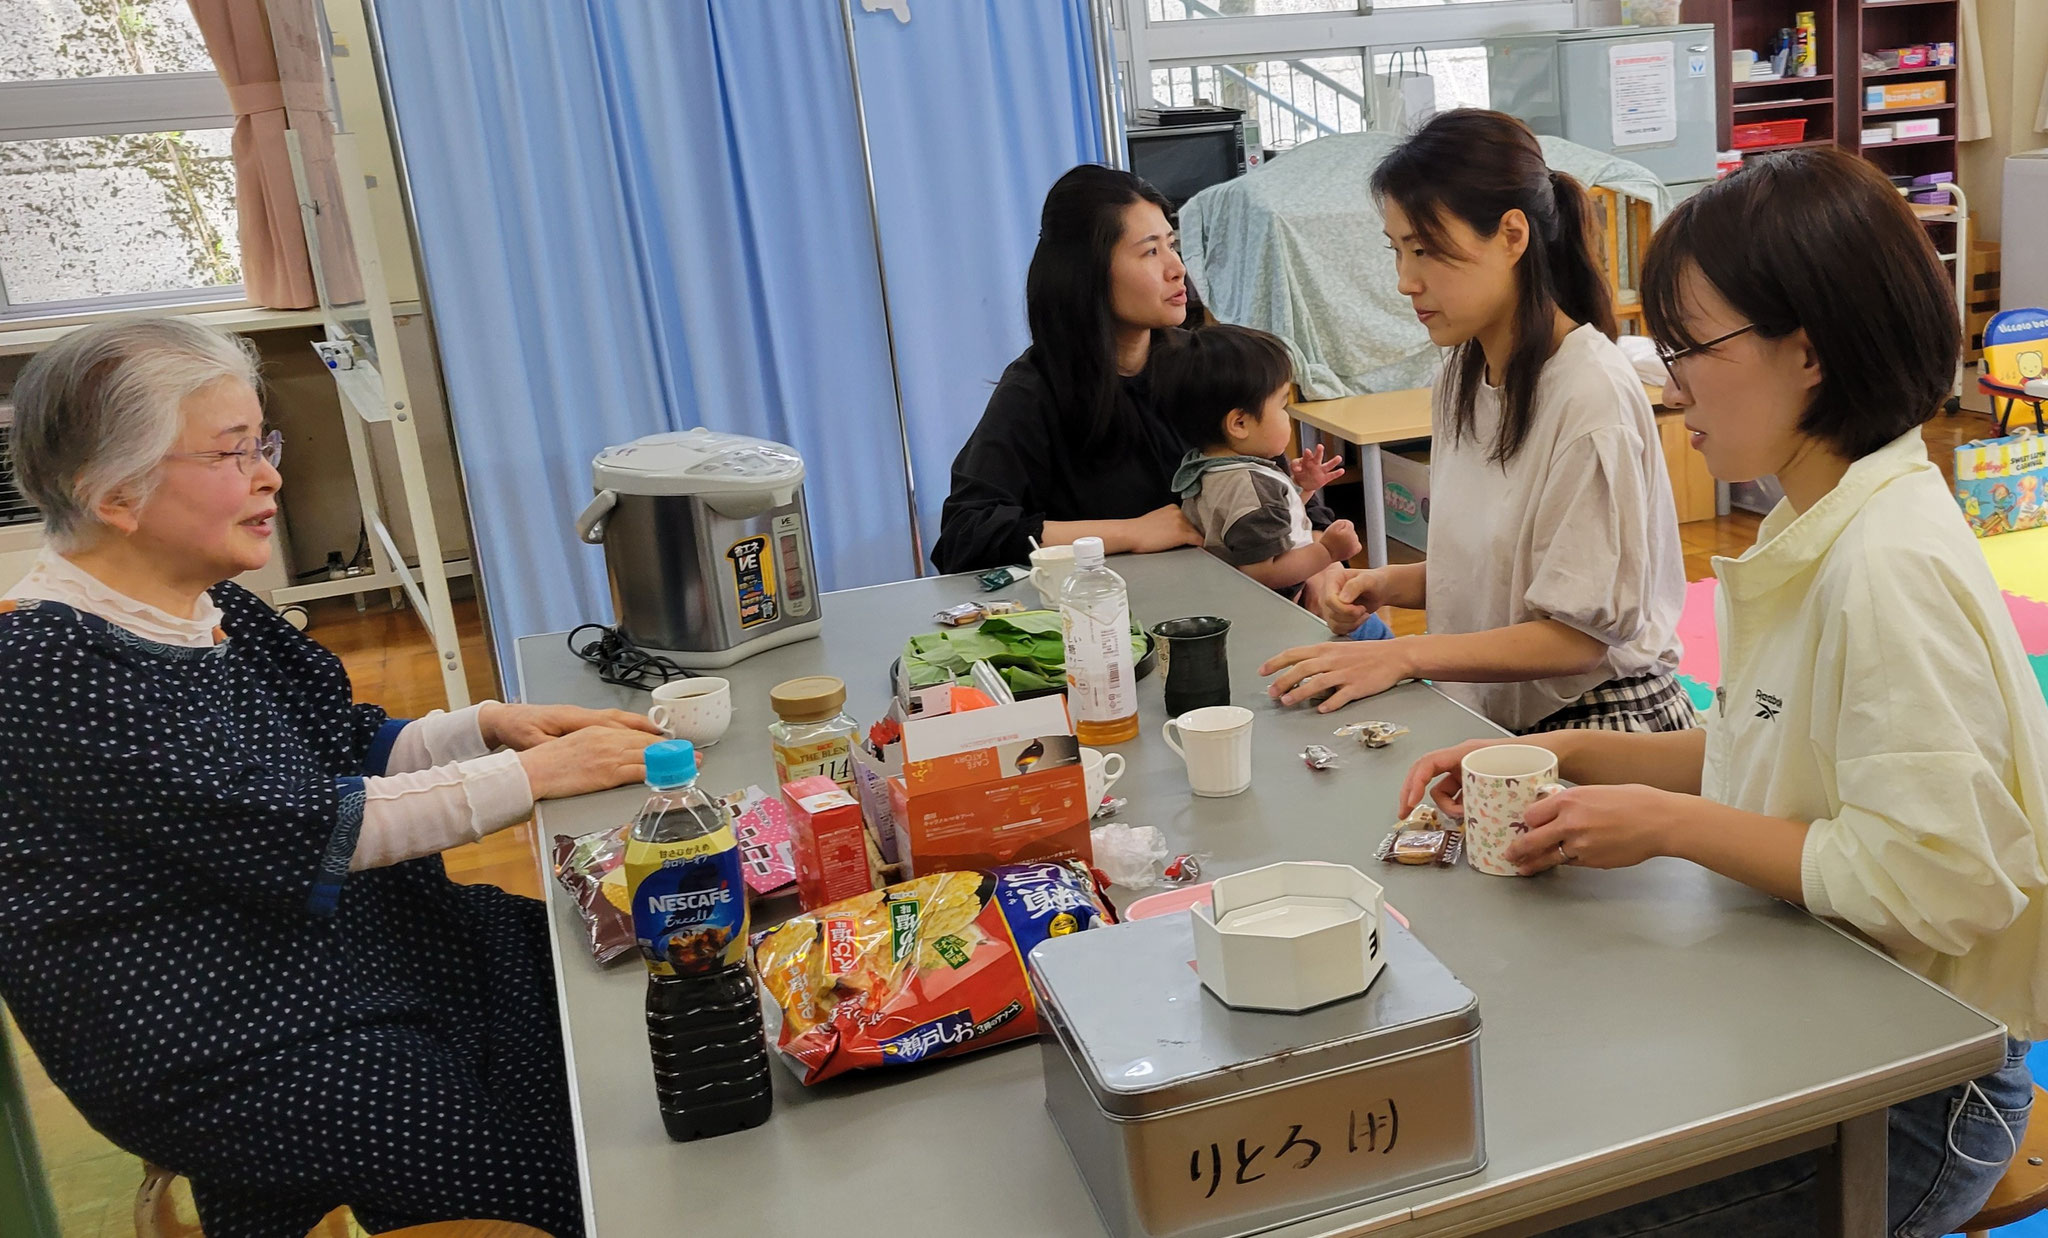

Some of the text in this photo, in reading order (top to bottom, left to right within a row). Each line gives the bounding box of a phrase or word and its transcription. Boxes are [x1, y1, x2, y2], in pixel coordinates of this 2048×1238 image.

[734, 541, 760, 558] 省エネ
[738, 554, 759, 572] VE
[799, 752, 819, 763] THE
[818, 758, 851, 781] 114
[659, 843, 711, 860] 甘さひかえめ
[663, 854, 709, 869] カロリーオフ
[665, 909, 721, 928] Excella
[830, 920, 854, 973] えび塩味
[897, 1022, 975, 1058] 瀬戸しお
